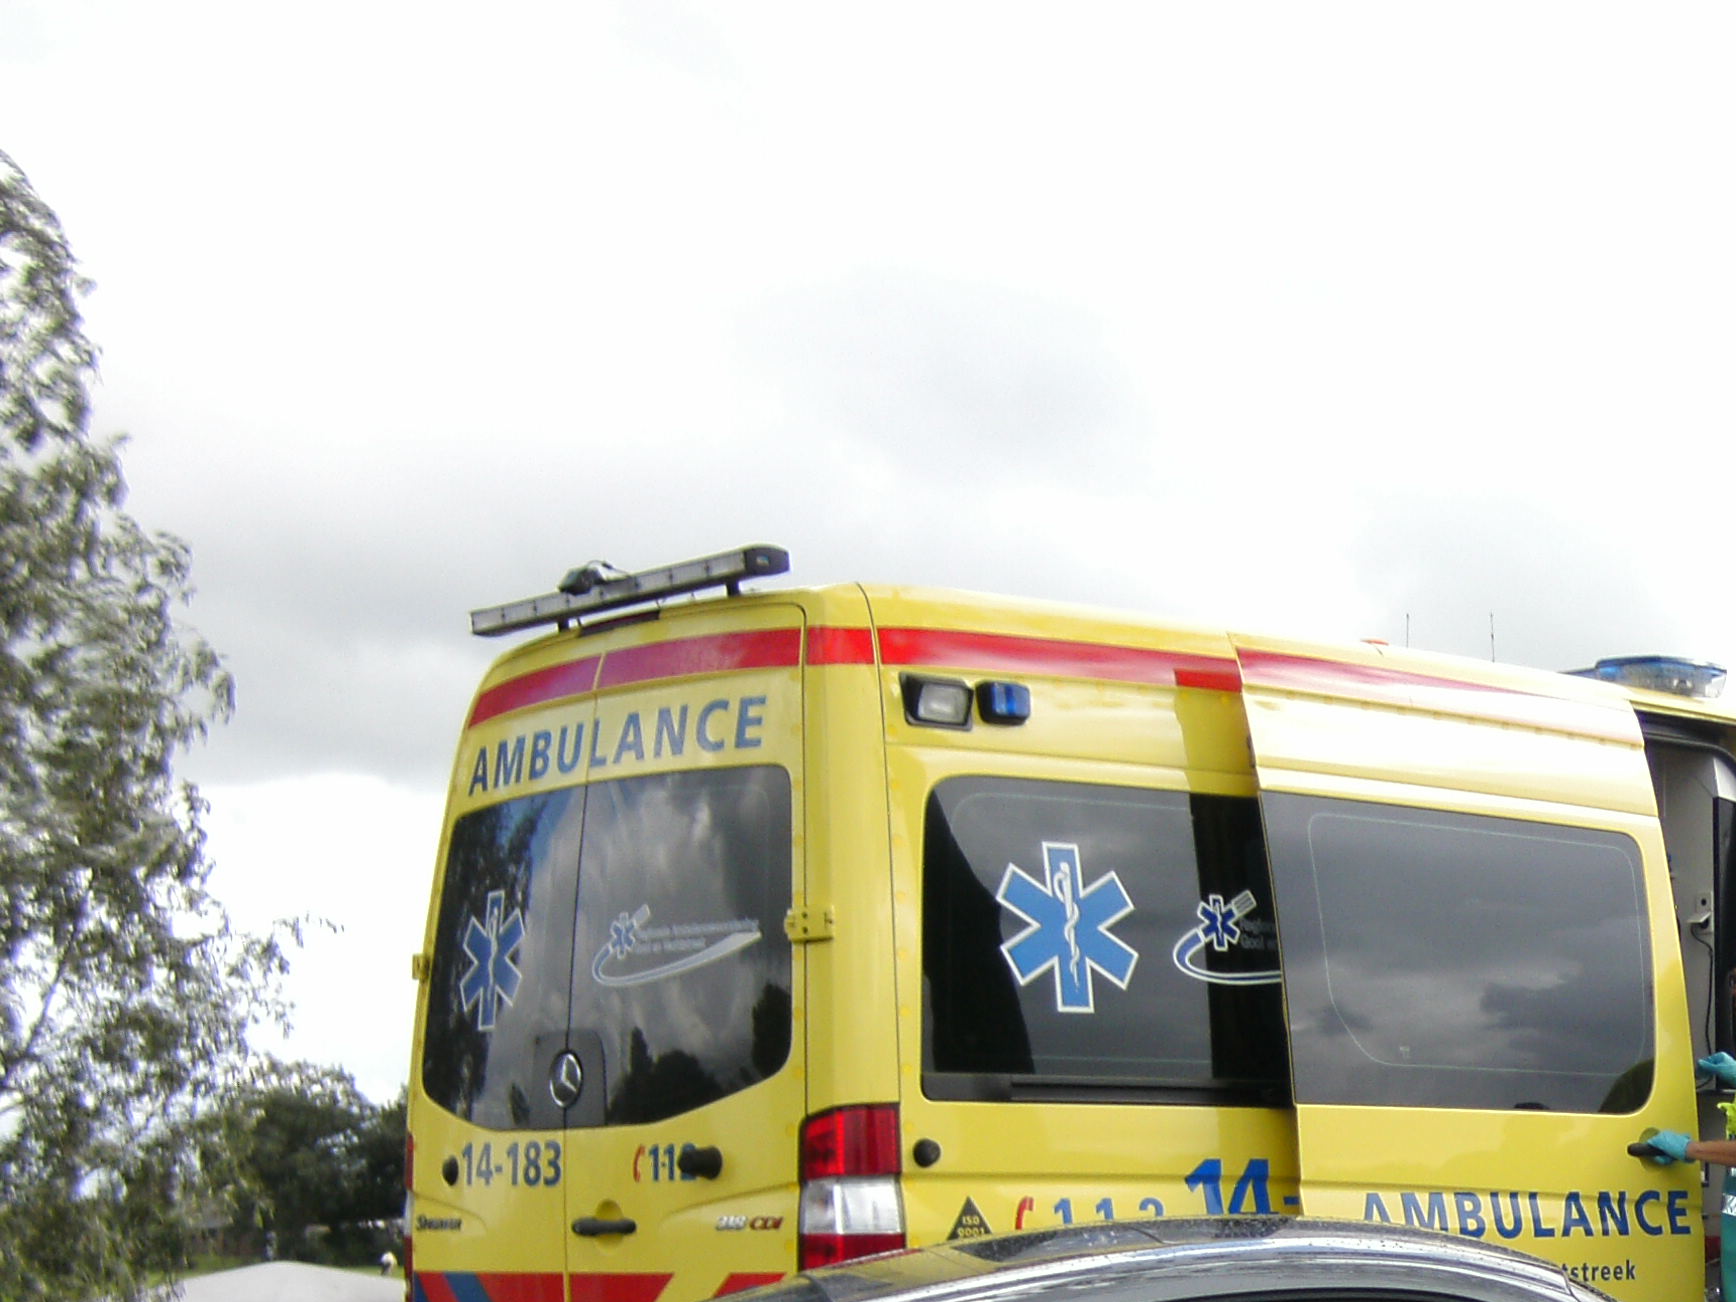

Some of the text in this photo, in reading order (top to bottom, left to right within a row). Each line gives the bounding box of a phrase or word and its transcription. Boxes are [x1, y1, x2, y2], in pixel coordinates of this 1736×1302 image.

[467, 695, 767, 797] AMBULANCE
[462, 1141, 562, 1186] 14-183
[1363, 1190, 1692, 1239] AMBULANCE
